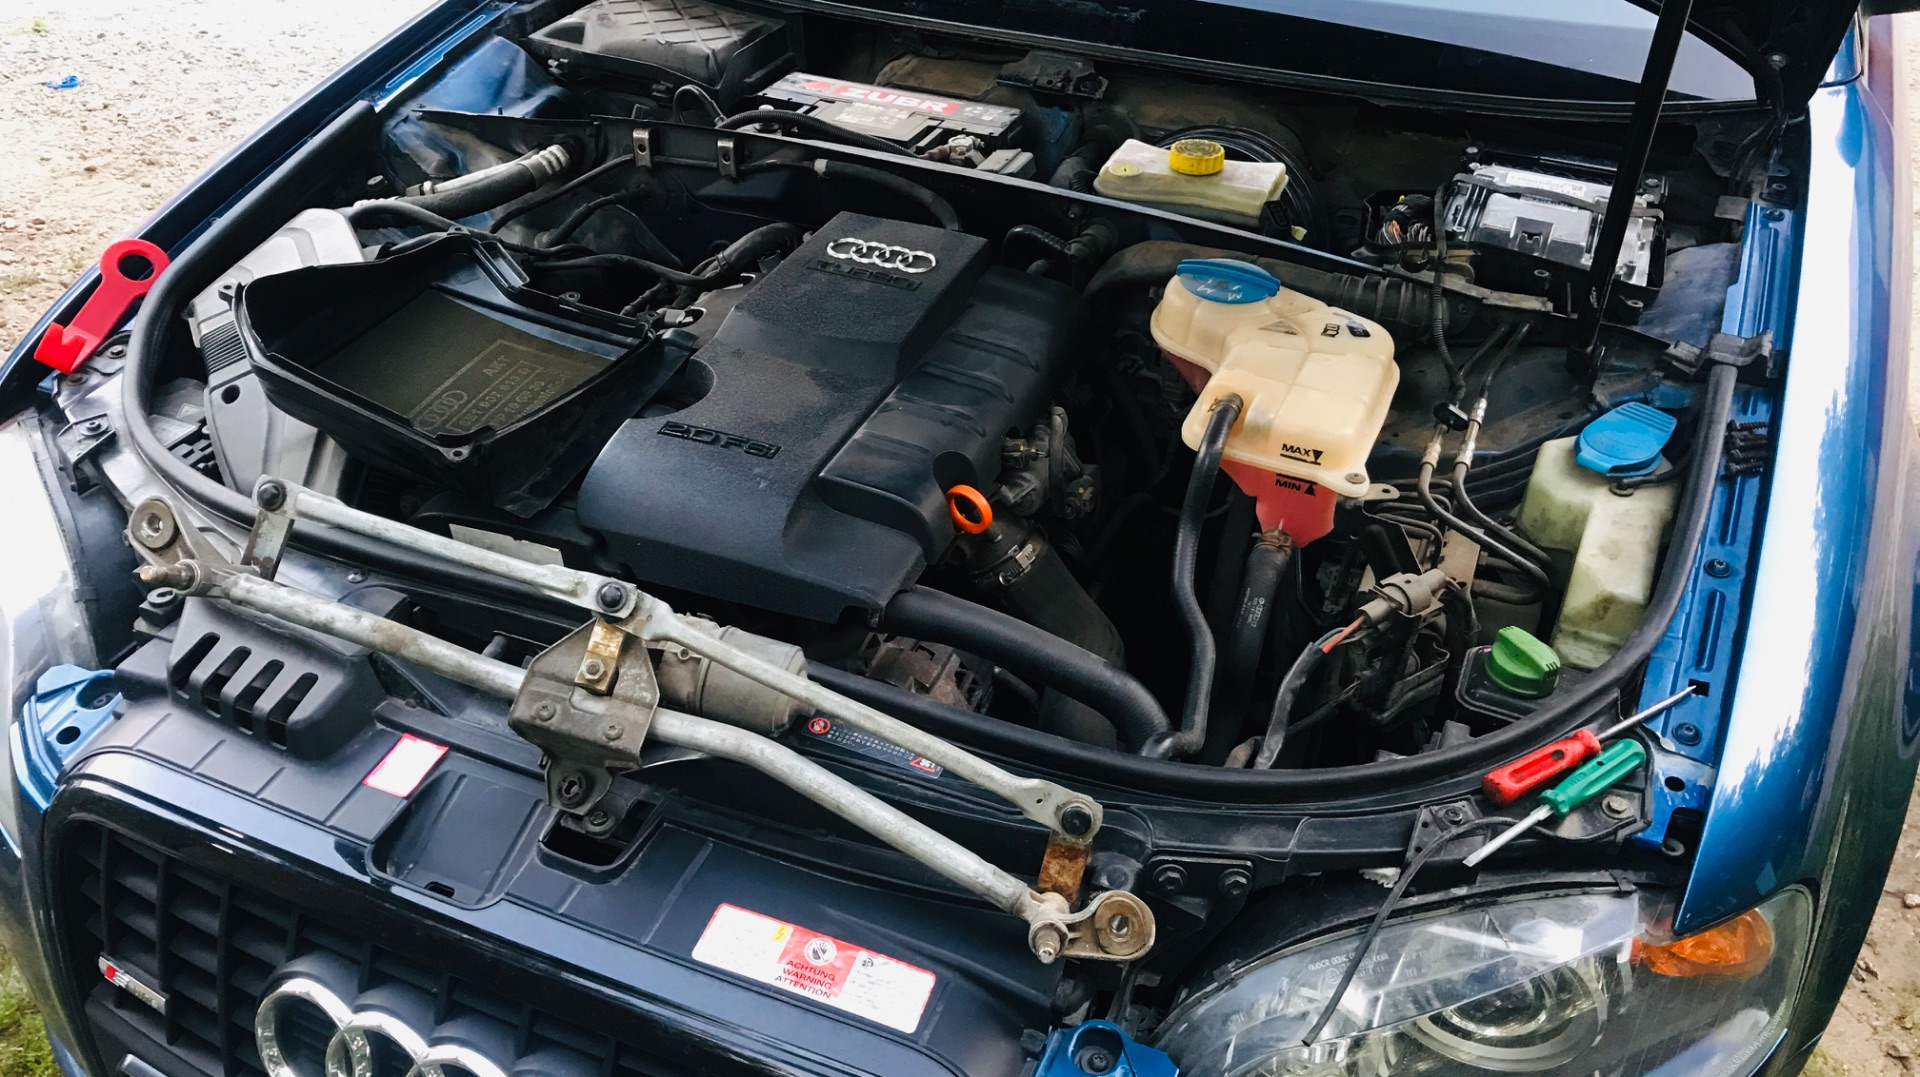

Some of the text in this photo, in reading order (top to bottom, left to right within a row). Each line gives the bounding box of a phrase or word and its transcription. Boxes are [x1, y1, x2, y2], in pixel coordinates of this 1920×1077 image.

[838, 86, 945, 113] ZUBR
[1281, 443, 1311, 457] MAX
[1275, 479, 1301, 491] MIN
[782, 967, 832, 990] WARNING
[785, 960, 836, 981] ACHTUNG
[774, 975, 831, 999] ATTENTION
